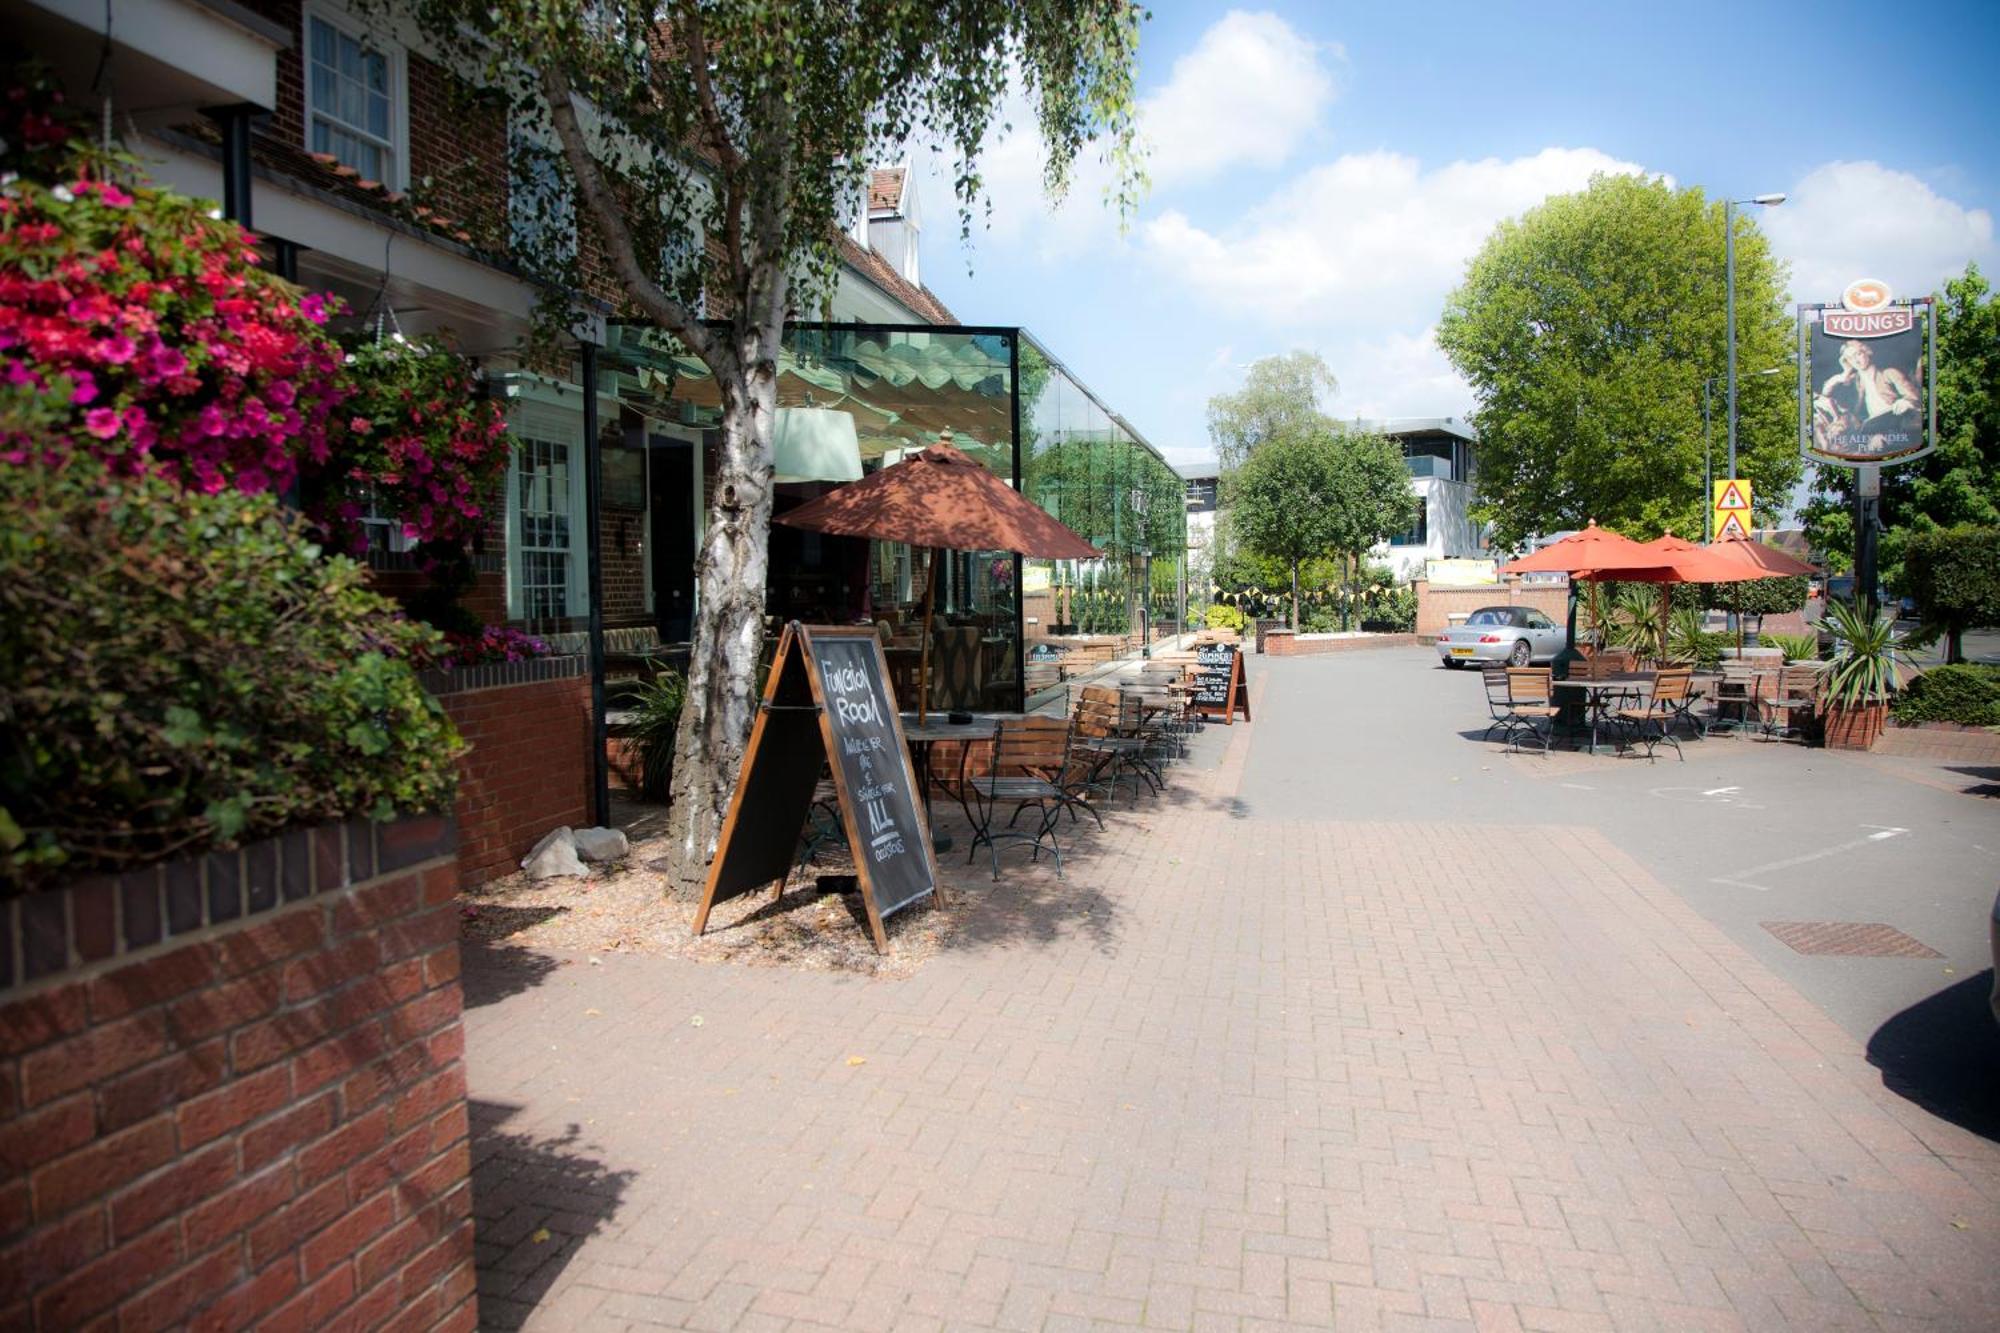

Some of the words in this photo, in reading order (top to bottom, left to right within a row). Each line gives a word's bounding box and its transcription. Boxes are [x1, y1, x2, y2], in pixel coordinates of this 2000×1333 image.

[1830, 313, 1905, 332] YOUNG'S
[1849, 433, 1909, 444] ALEXNDER
[867, 798, 895, 834] ALL
